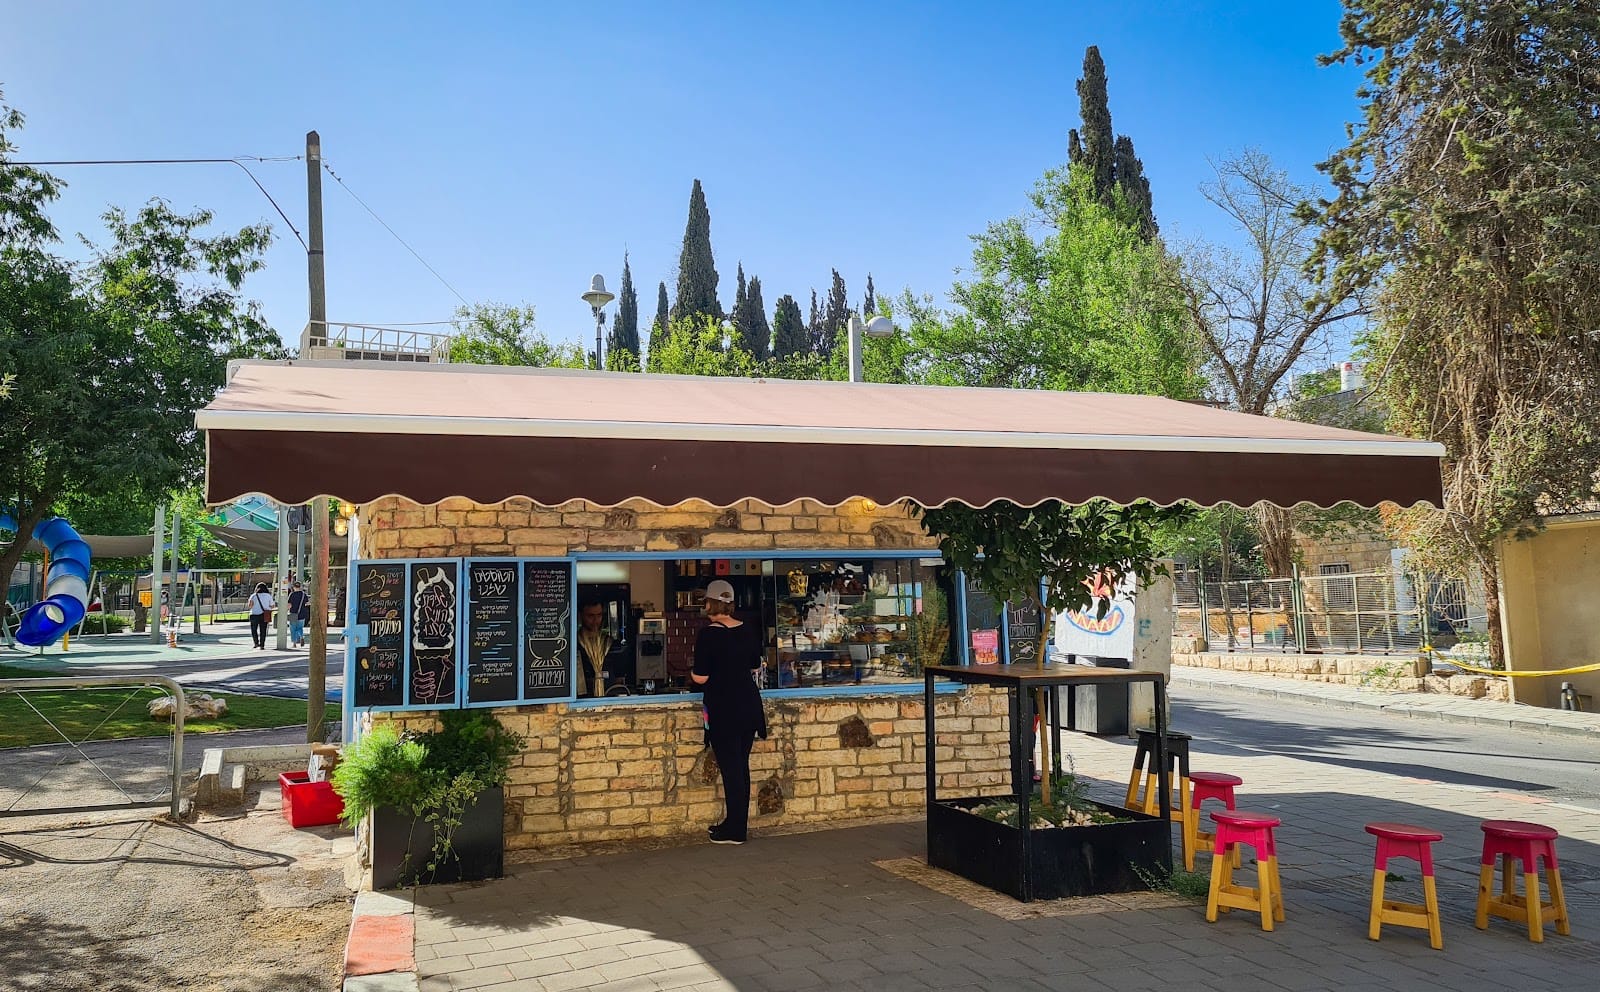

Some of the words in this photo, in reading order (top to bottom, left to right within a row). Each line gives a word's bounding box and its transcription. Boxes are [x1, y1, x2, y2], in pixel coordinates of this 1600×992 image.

[474, 570, 514, 583] הטוסטים
[478, 583, 507, 596] שלנו
[423, 622, 447, 637] שלנו
[379, 682, 386, 691] 5
